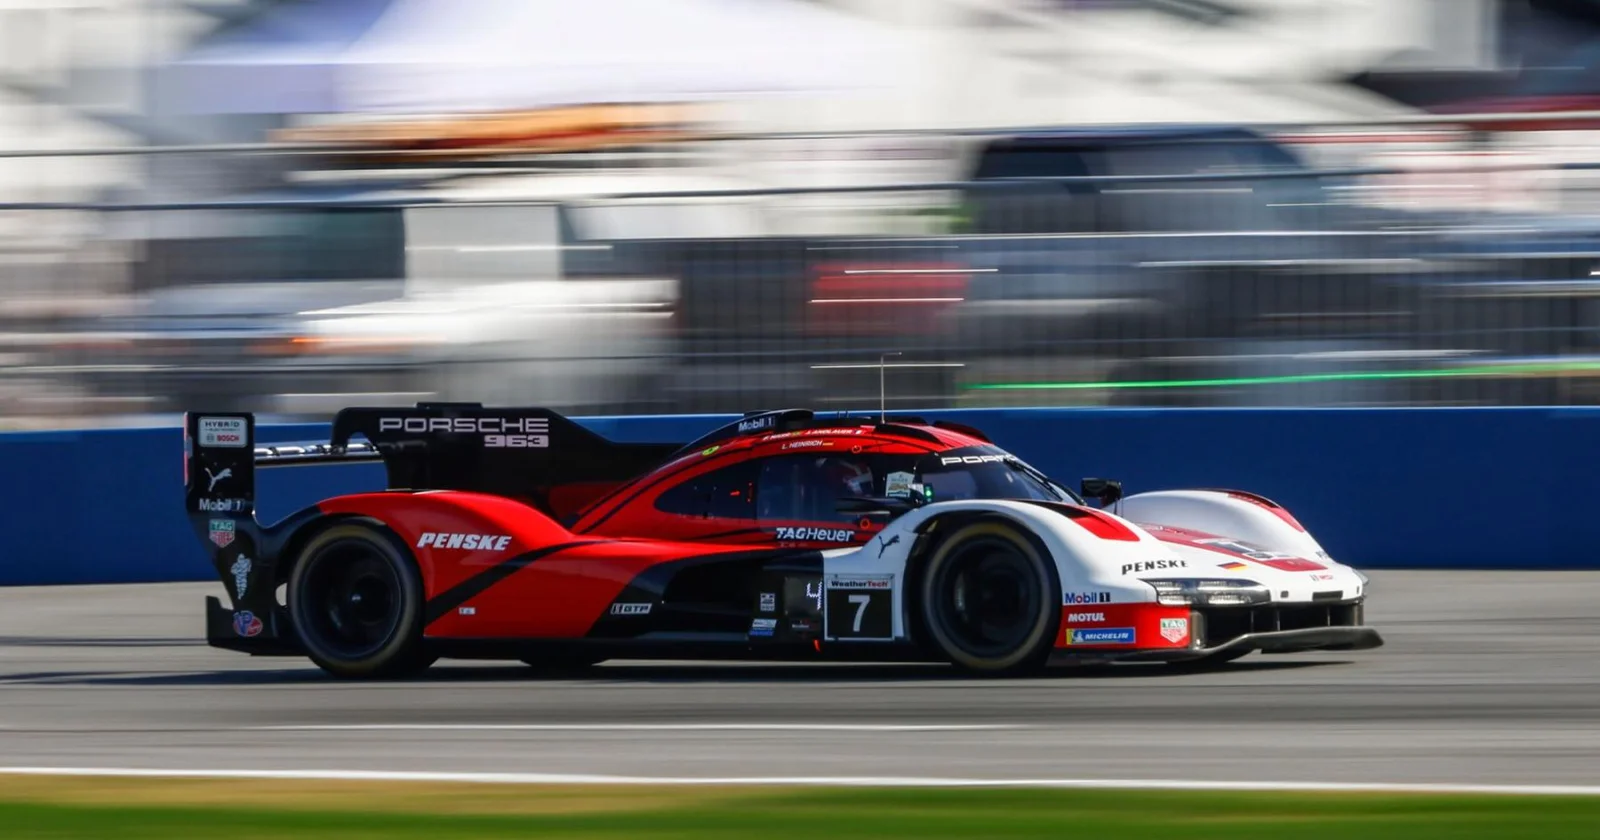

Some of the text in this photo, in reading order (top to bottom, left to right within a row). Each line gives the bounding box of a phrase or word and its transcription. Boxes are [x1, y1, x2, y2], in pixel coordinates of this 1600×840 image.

[379, 417, 549, 432] PORSCHE
[738, 418, 764, 431] Mobil
[216, 434, 240, 442] BOSCH
[484, 435, 549, 448] 963
[789, 440, 822, 448] HEINRICH
[199, 498, 231, 511] Mobil
[212, 522, 233, 530] TAG
[417, 532, 513, 551] PENSKE
[1121, 560, 1188, 575] PENSKE
[831, 580, 888, 588] WeatherTech
[1064, 592, 1110, 603] Mobil 1
[848, 594, 871, 632] 7
[1068, 612, 1105, 622] MOTUL
[1164, 619, 1186, 628] TAG
[1085, 632, 1129, 640] MICHELIN
